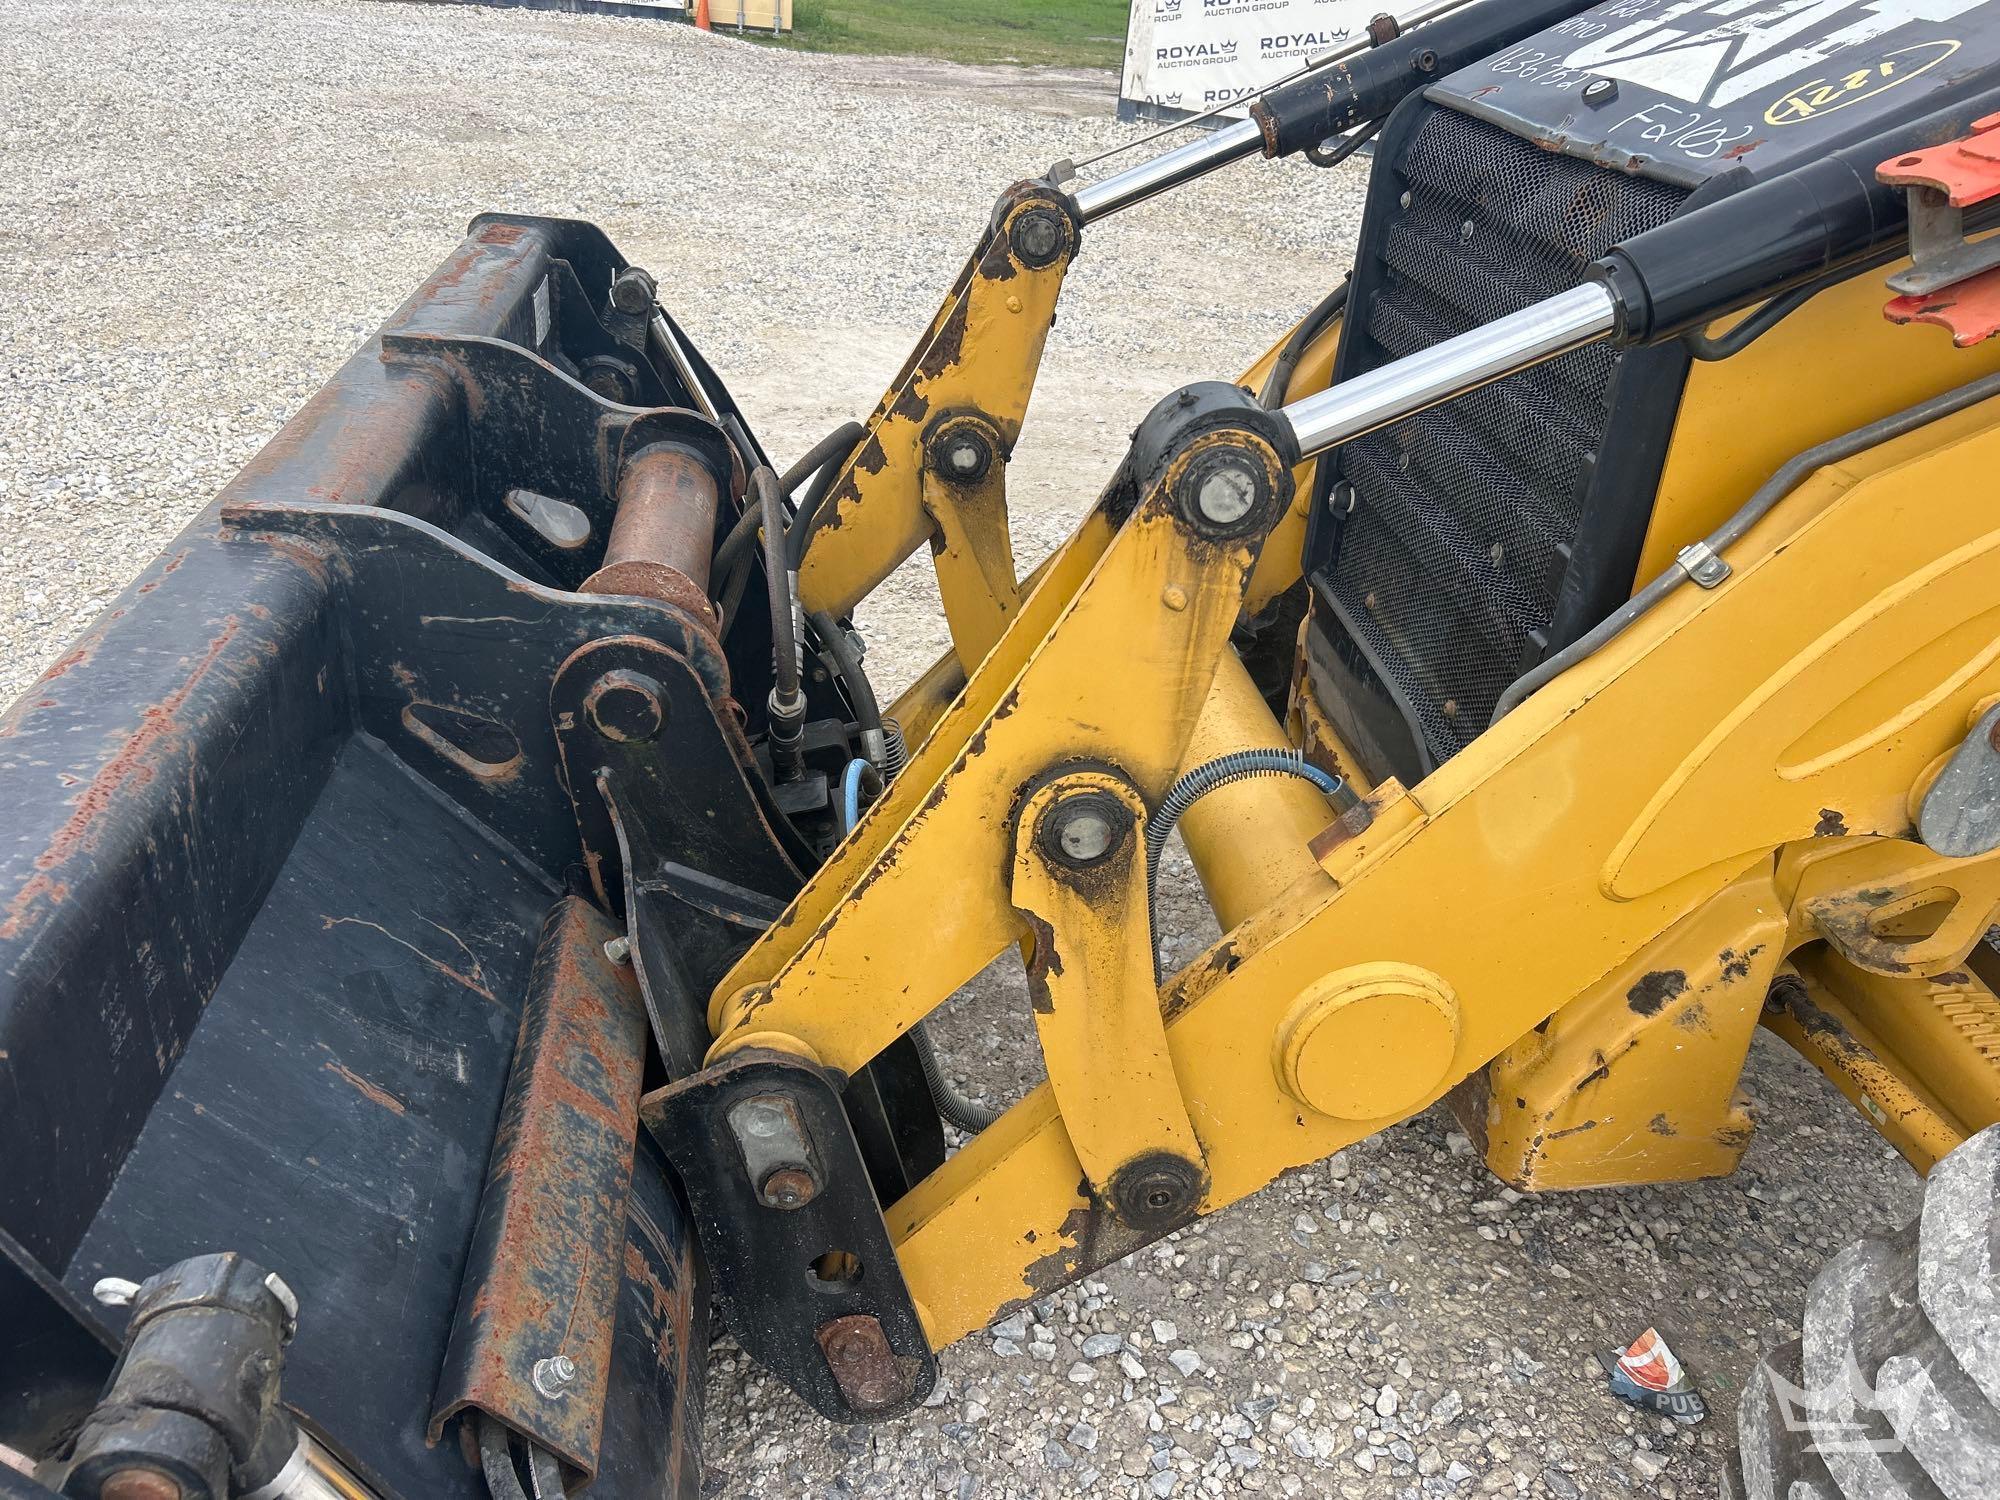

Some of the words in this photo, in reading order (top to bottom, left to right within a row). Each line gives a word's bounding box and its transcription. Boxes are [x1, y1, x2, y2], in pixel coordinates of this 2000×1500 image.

[1204, 5, 1250, 17] AUCTION
[1252, 1, 1290, 12] GROUP
[1154, 14, 1182, 23] ROUP
[1261, 31, 1330, 49] ROYAL
[1156, 43, 1220, 60] ROYAL
[1260, 48, 1309, 60] AUCTION
[1157, 59, 1201, 69] AUCTION
[1202, 55, 1238, 65] GROUP
[1204, 87, 1257, 102] ROY
[1608, 102, 1754, 159] F2103
